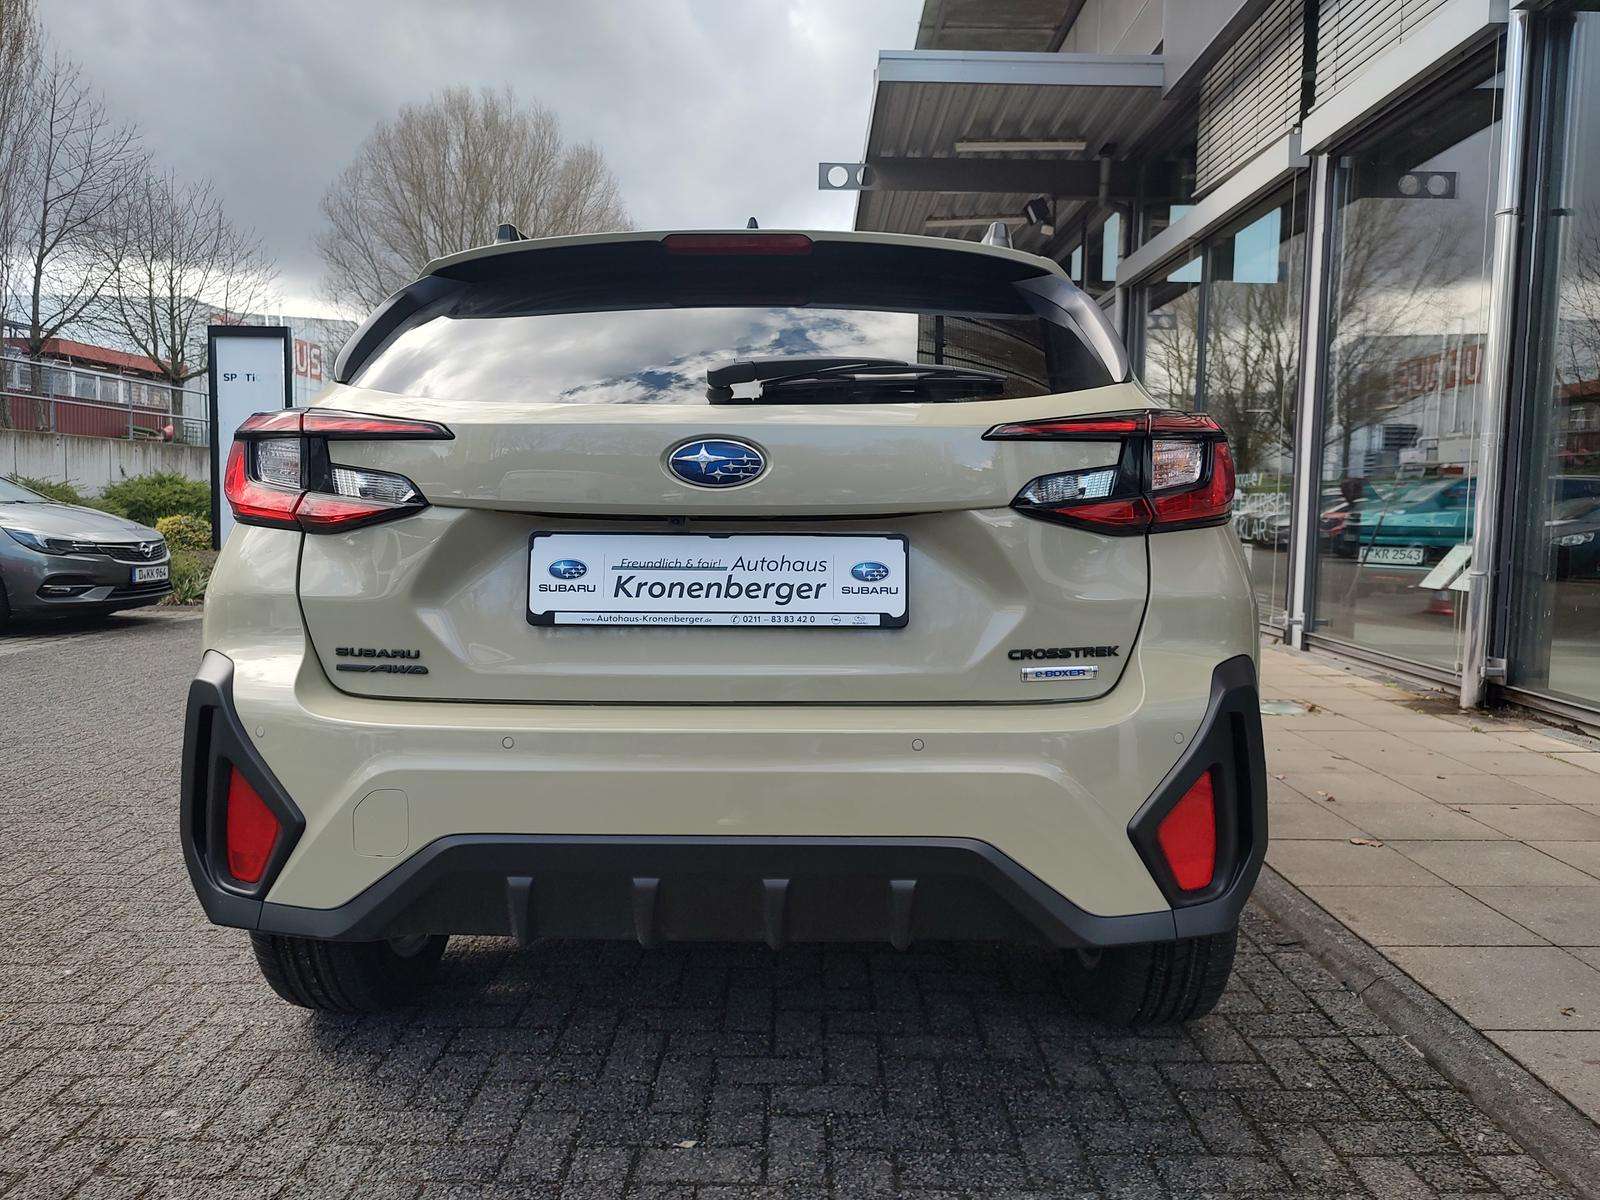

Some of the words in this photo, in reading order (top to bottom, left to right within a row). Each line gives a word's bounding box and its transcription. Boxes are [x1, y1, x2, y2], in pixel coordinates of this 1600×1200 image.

[620, 558, 682, 569] Freundlich
[685, 558, 694, 569] &
[696, 558, 722, 570] fair!
[730, 555, 828, 572] Autohaus
[538, 584, 596, 592] SUBARU
[613, 574, 828, 605] Kronenberger
[841, 586, 899, 595] SUBARU
[581, 614, 713, 625] www.Autohaus-Kronenberger.de
[742, 615, 761, 624] 0211
[771, 615, 782, 624] 83
[783, 615, 795, 624] 83
[796, 615, 808, 624] 42
[809, 615, 815, 624] 0
[335, 647, 420, 659] SUBARU
[1008, 645, 1120, 660] CROSSTREK
[1035, 669, 1086, 678] e-BOXER
